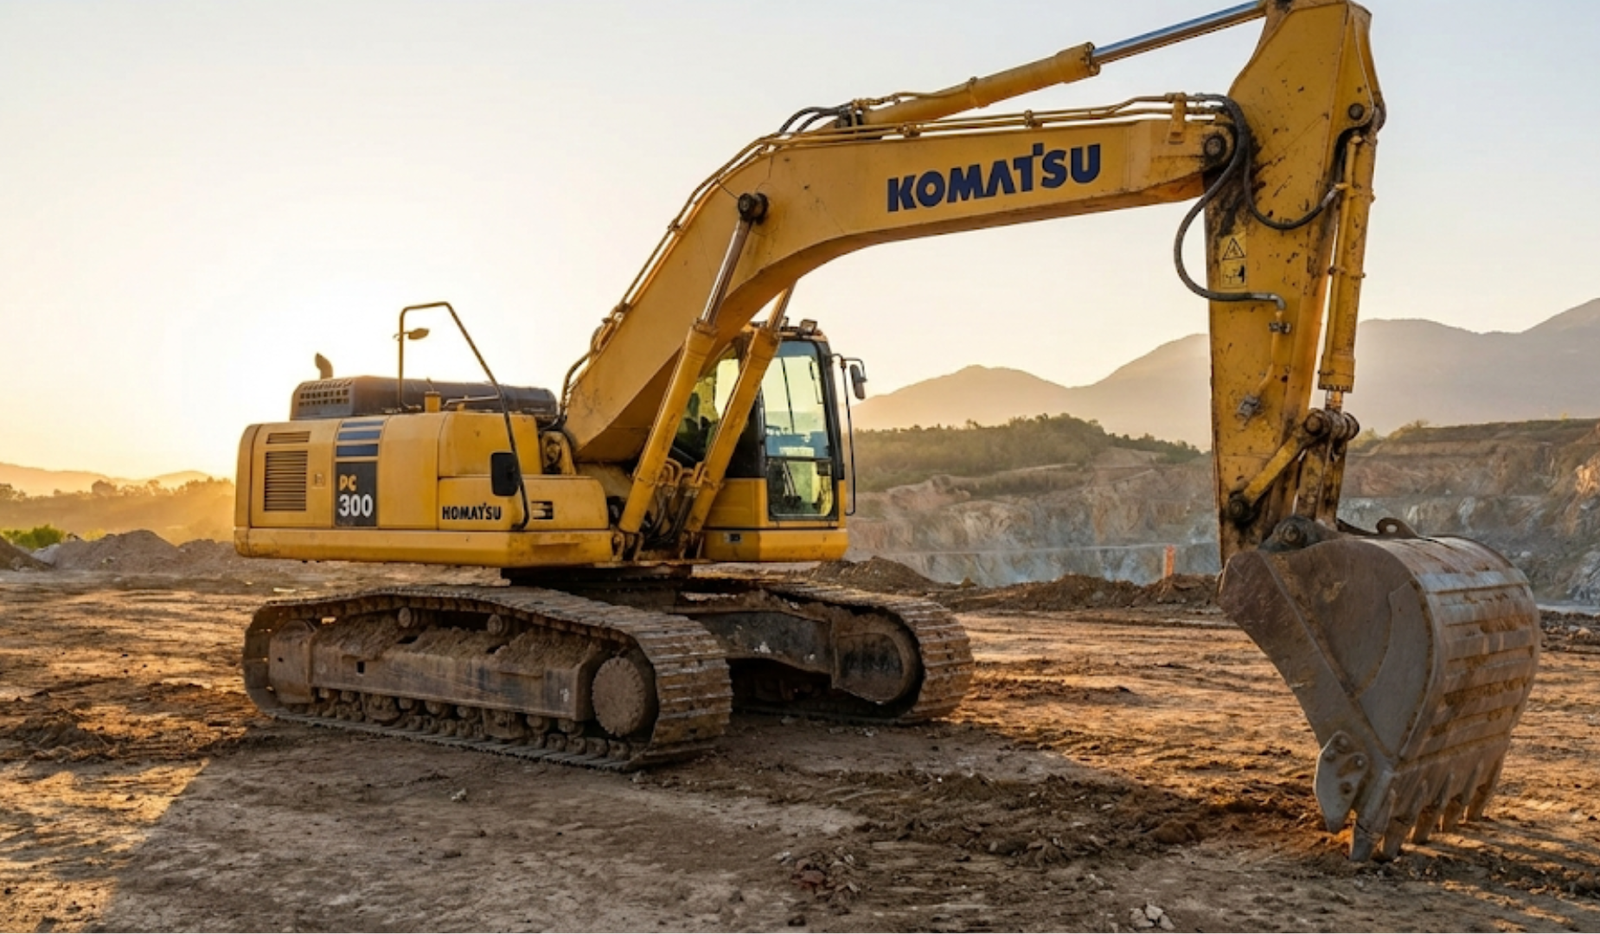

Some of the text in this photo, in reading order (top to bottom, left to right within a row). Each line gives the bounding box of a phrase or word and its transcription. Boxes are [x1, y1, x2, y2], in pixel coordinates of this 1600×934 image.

[887, 142, 1101, 212] KOMATSU
[339, 474, 357, 491] PC
[338, 493, 373, 517] 300
